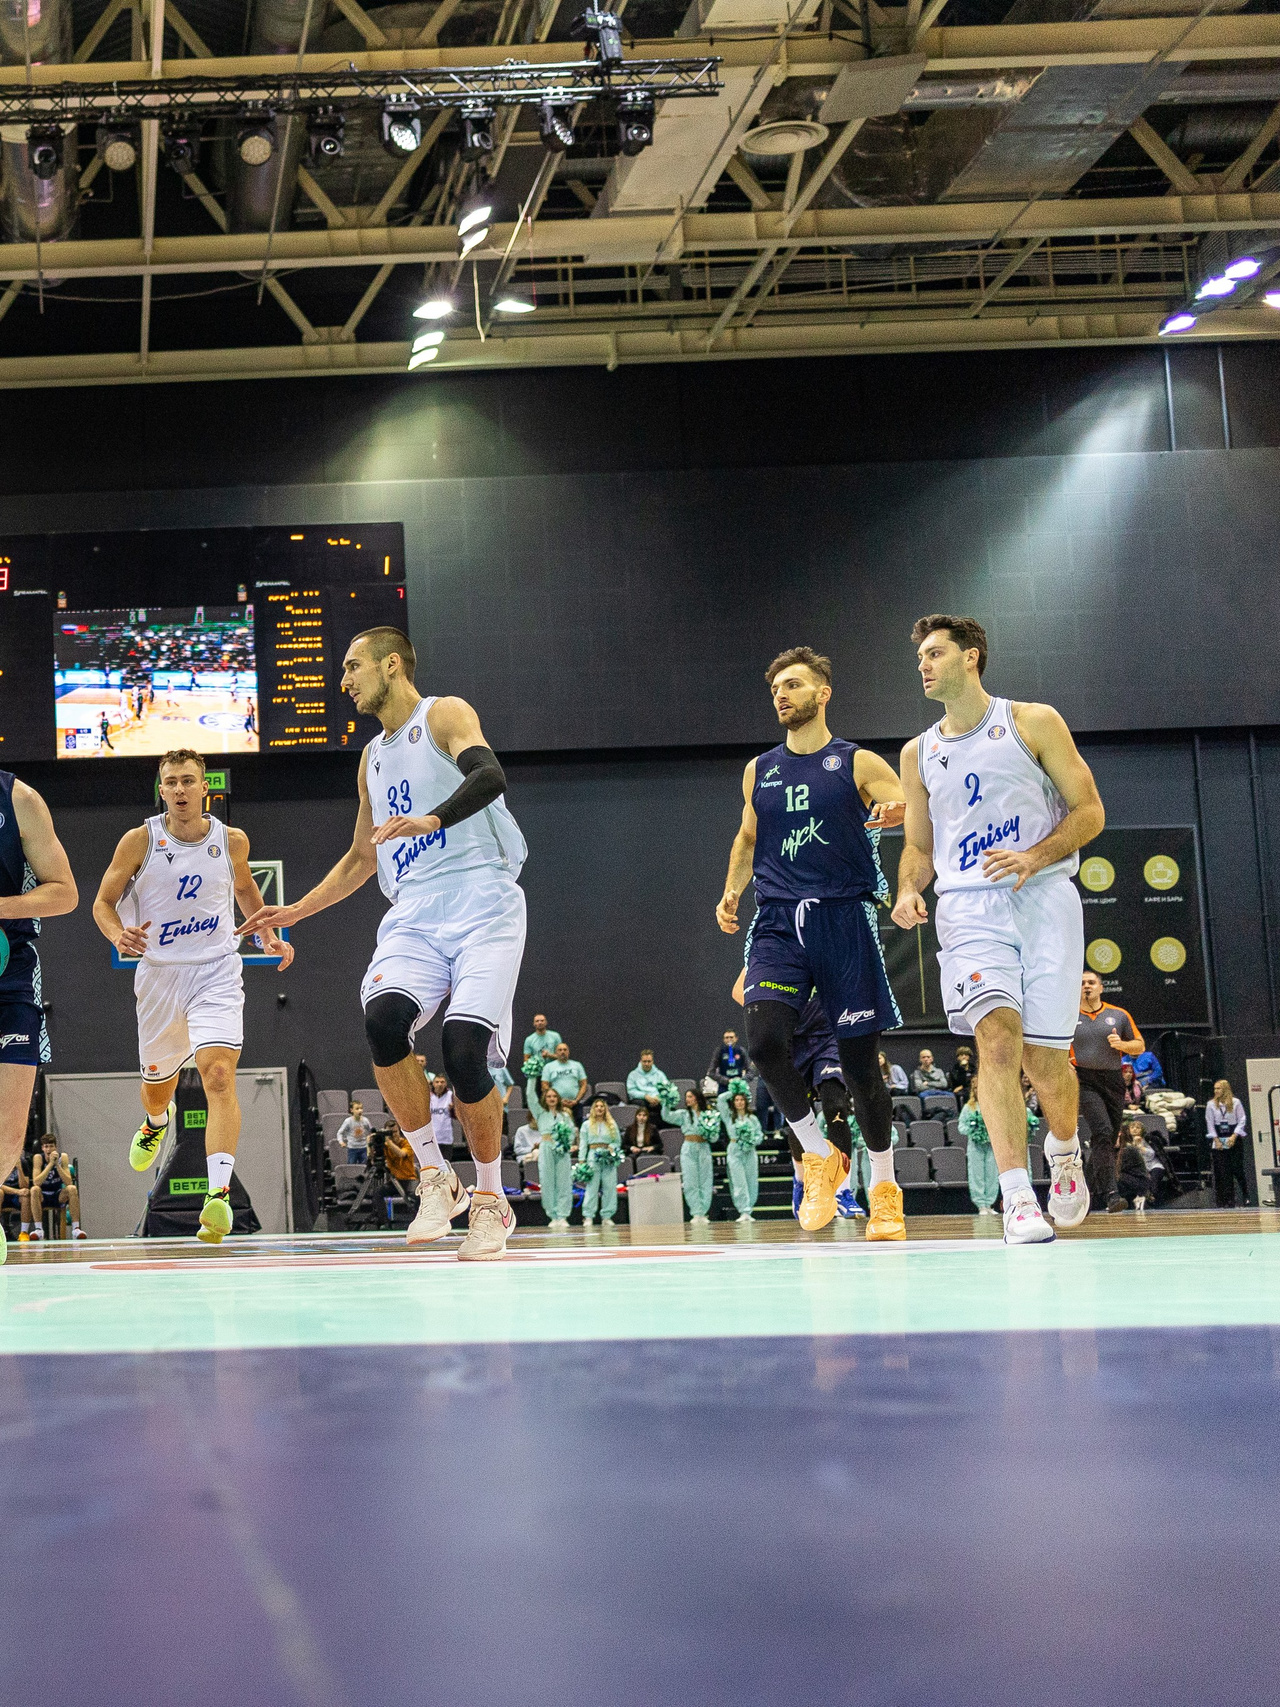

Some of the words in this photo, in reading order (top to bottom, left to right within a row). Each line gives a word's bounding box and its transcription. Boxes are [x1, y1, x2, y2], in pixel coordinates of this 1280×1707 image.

[347, 721, 355, 733] 3
[387, 779, 412, 817] 33
[761, 780, 782, 788] Kempa
[784, 784, 809, 812] 12
[964, 772, 982, 807] 2
[958, 816, 1020, 872] Enisey
[176, 875, 202, 900] 12
[158, 914, 219, 946] Enisey
